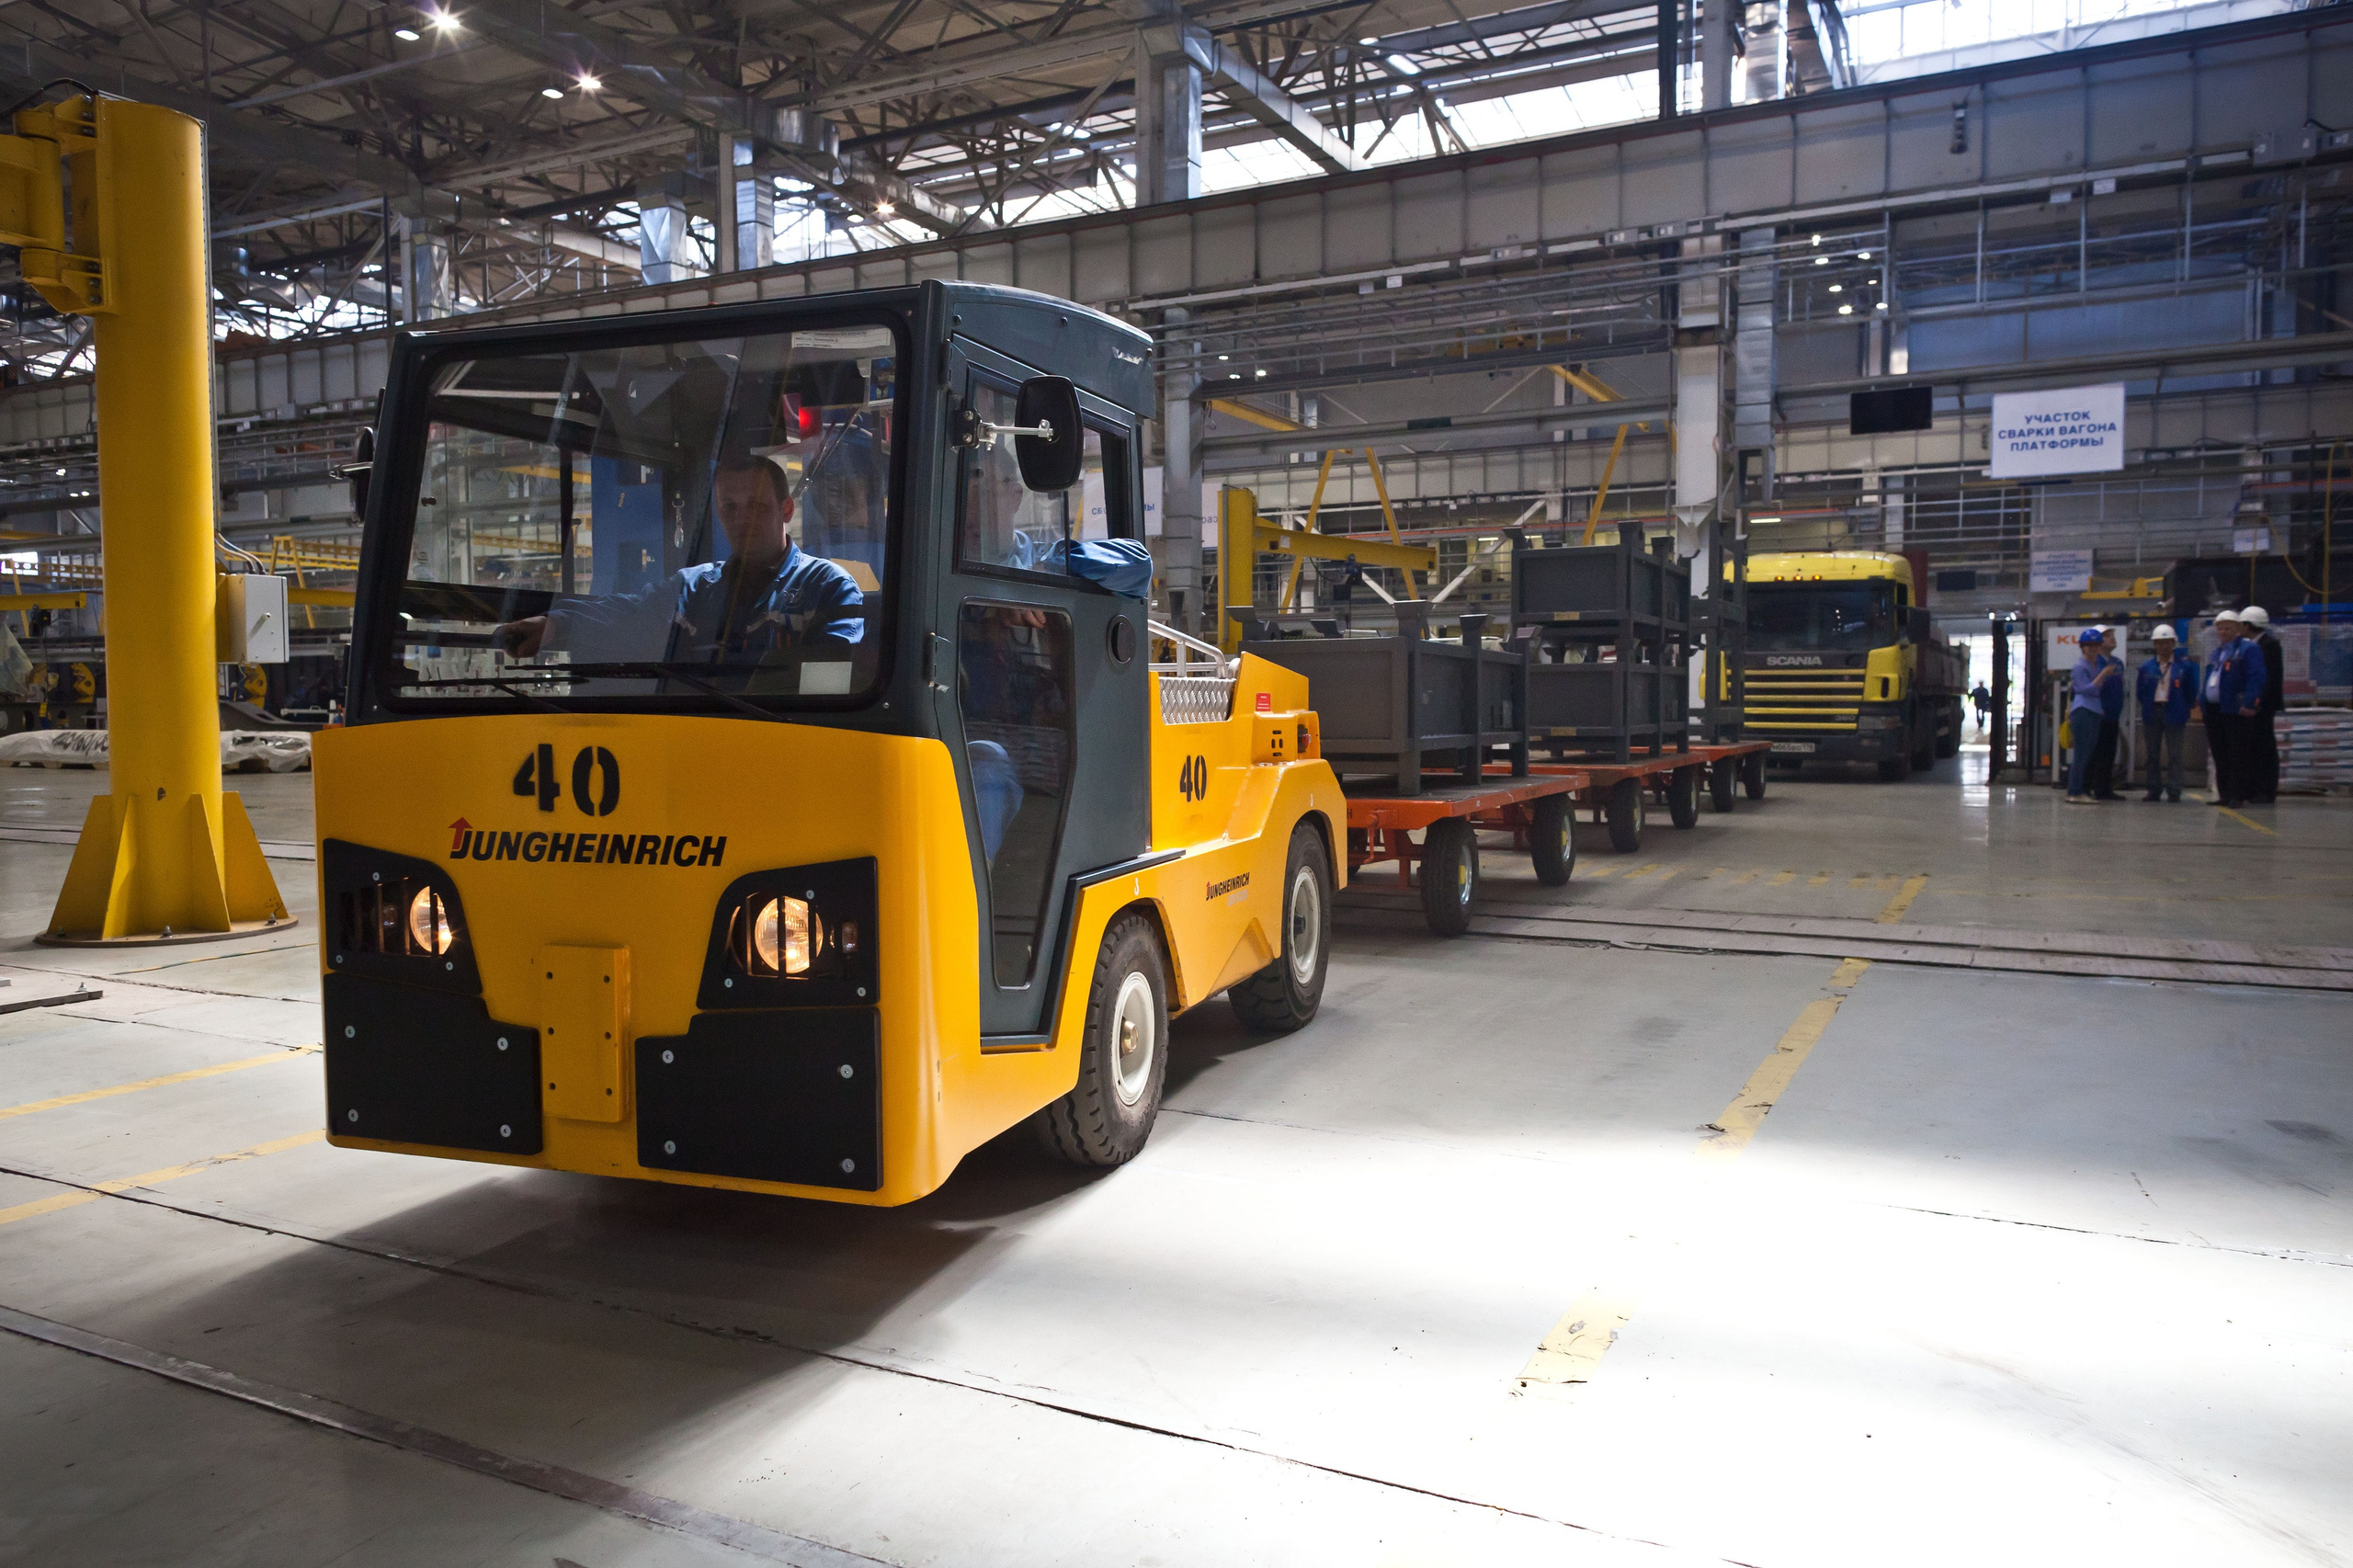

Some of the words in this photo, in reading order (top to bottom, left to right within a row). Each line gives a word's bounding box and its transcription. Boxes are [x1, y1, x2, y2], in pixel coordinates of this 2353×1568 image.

[2025, 410, 2091, 425] УЧАСТОК
[1997, 426, 2055, 439] СВАРКИ
[2059, 422, 2117, 436] ВАГОНА
[2010, 437, 2104, 451] ПЛАТФОРМЫ
[1767, 655, 1823, 665] SCANIA
[513, 744, 620, 817] 40
[1179, 755, 1207, 802] 40
[449, 830, 728, 868] JUNGHEINRICH
[1206, 871, 1250, 901] JUNGHEINRICH
